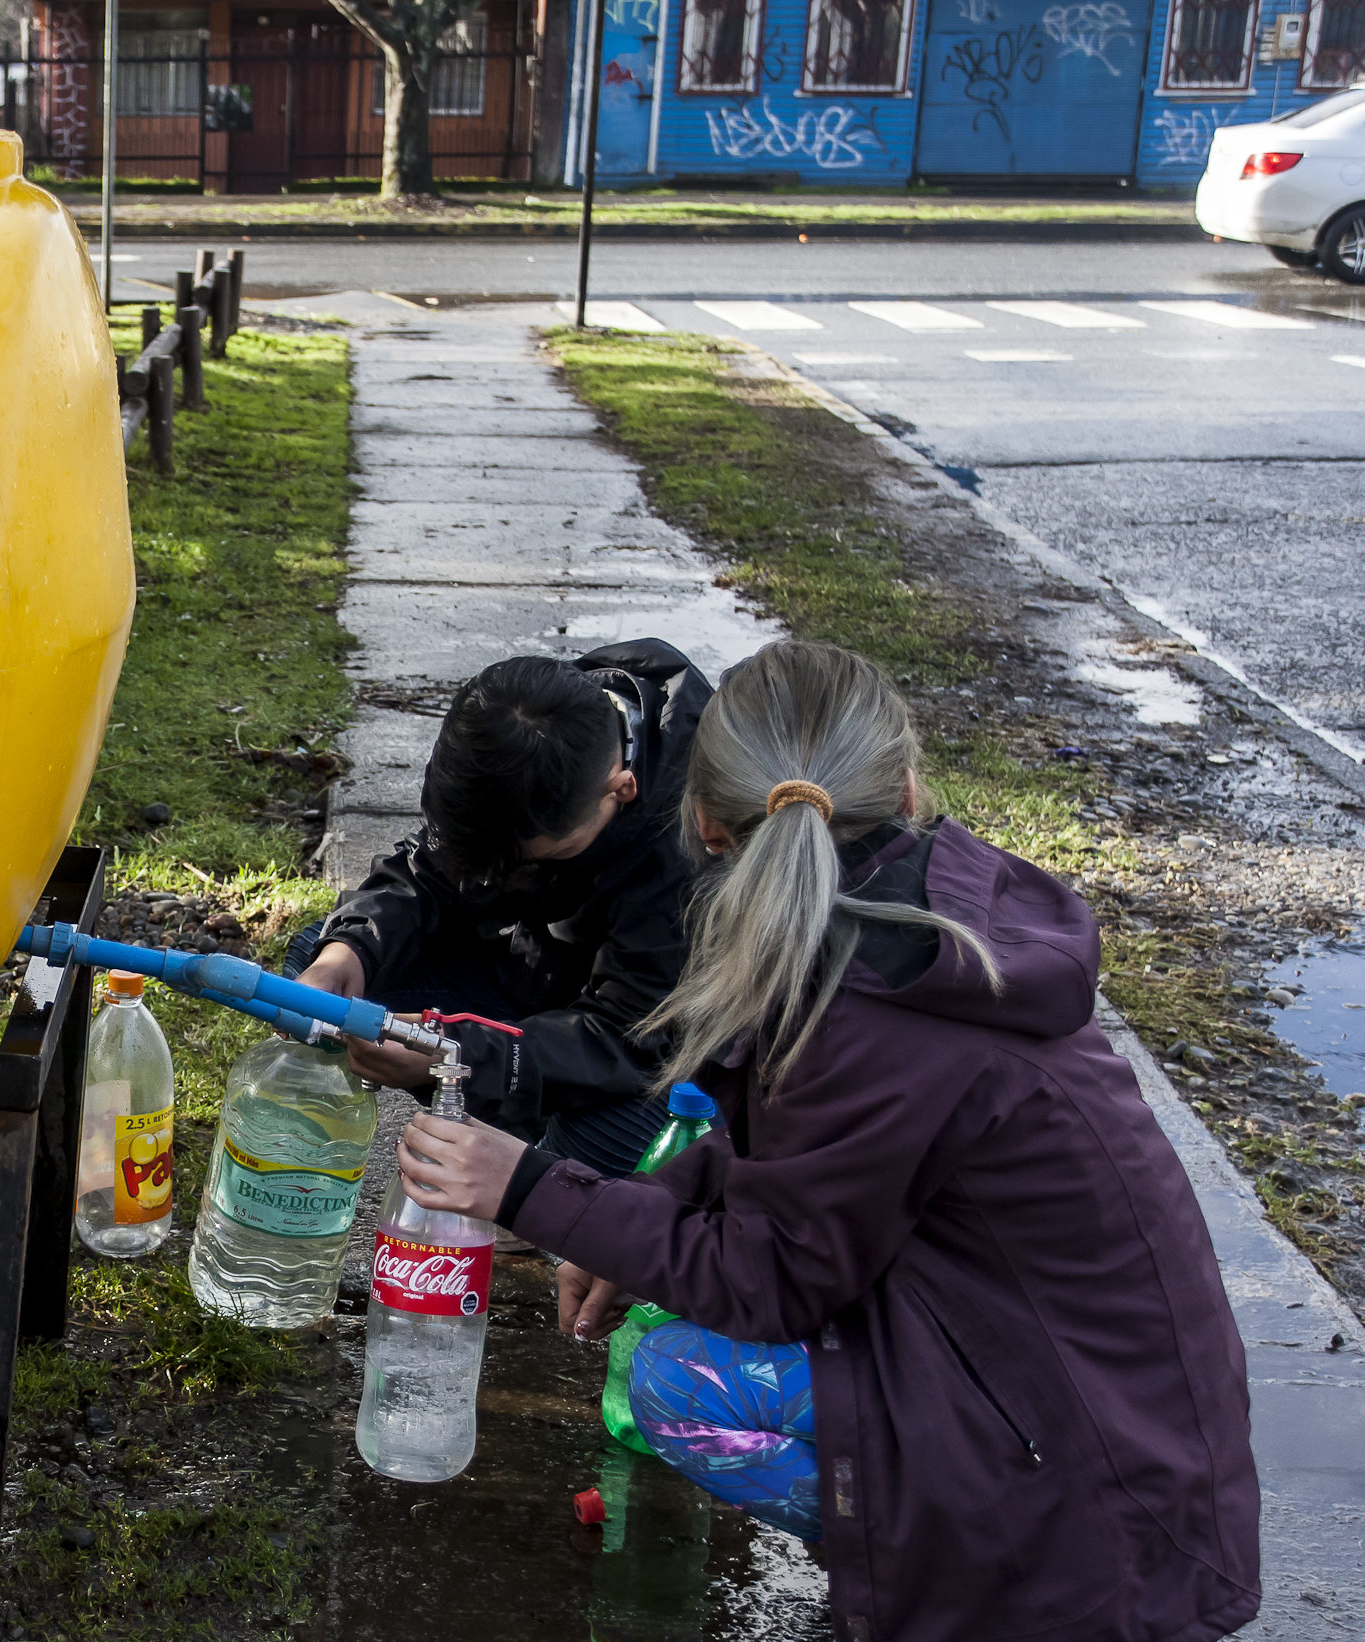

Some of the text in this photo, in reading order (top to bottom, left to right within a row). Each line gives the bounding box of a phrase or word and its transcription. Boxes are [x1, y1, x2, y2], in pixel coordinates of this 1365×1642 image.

[125, 1118, 145, 1130] 2.5
[237, 1178, 357, 1212] BENEDICTINO
[233, 1204, 247, 1217] 6.5
[384, 1235, 461, 1254] RETORNABLE
[373, 1244, 476, 1296] Coca-Cola
[402, 1292, 424, 1300] original
